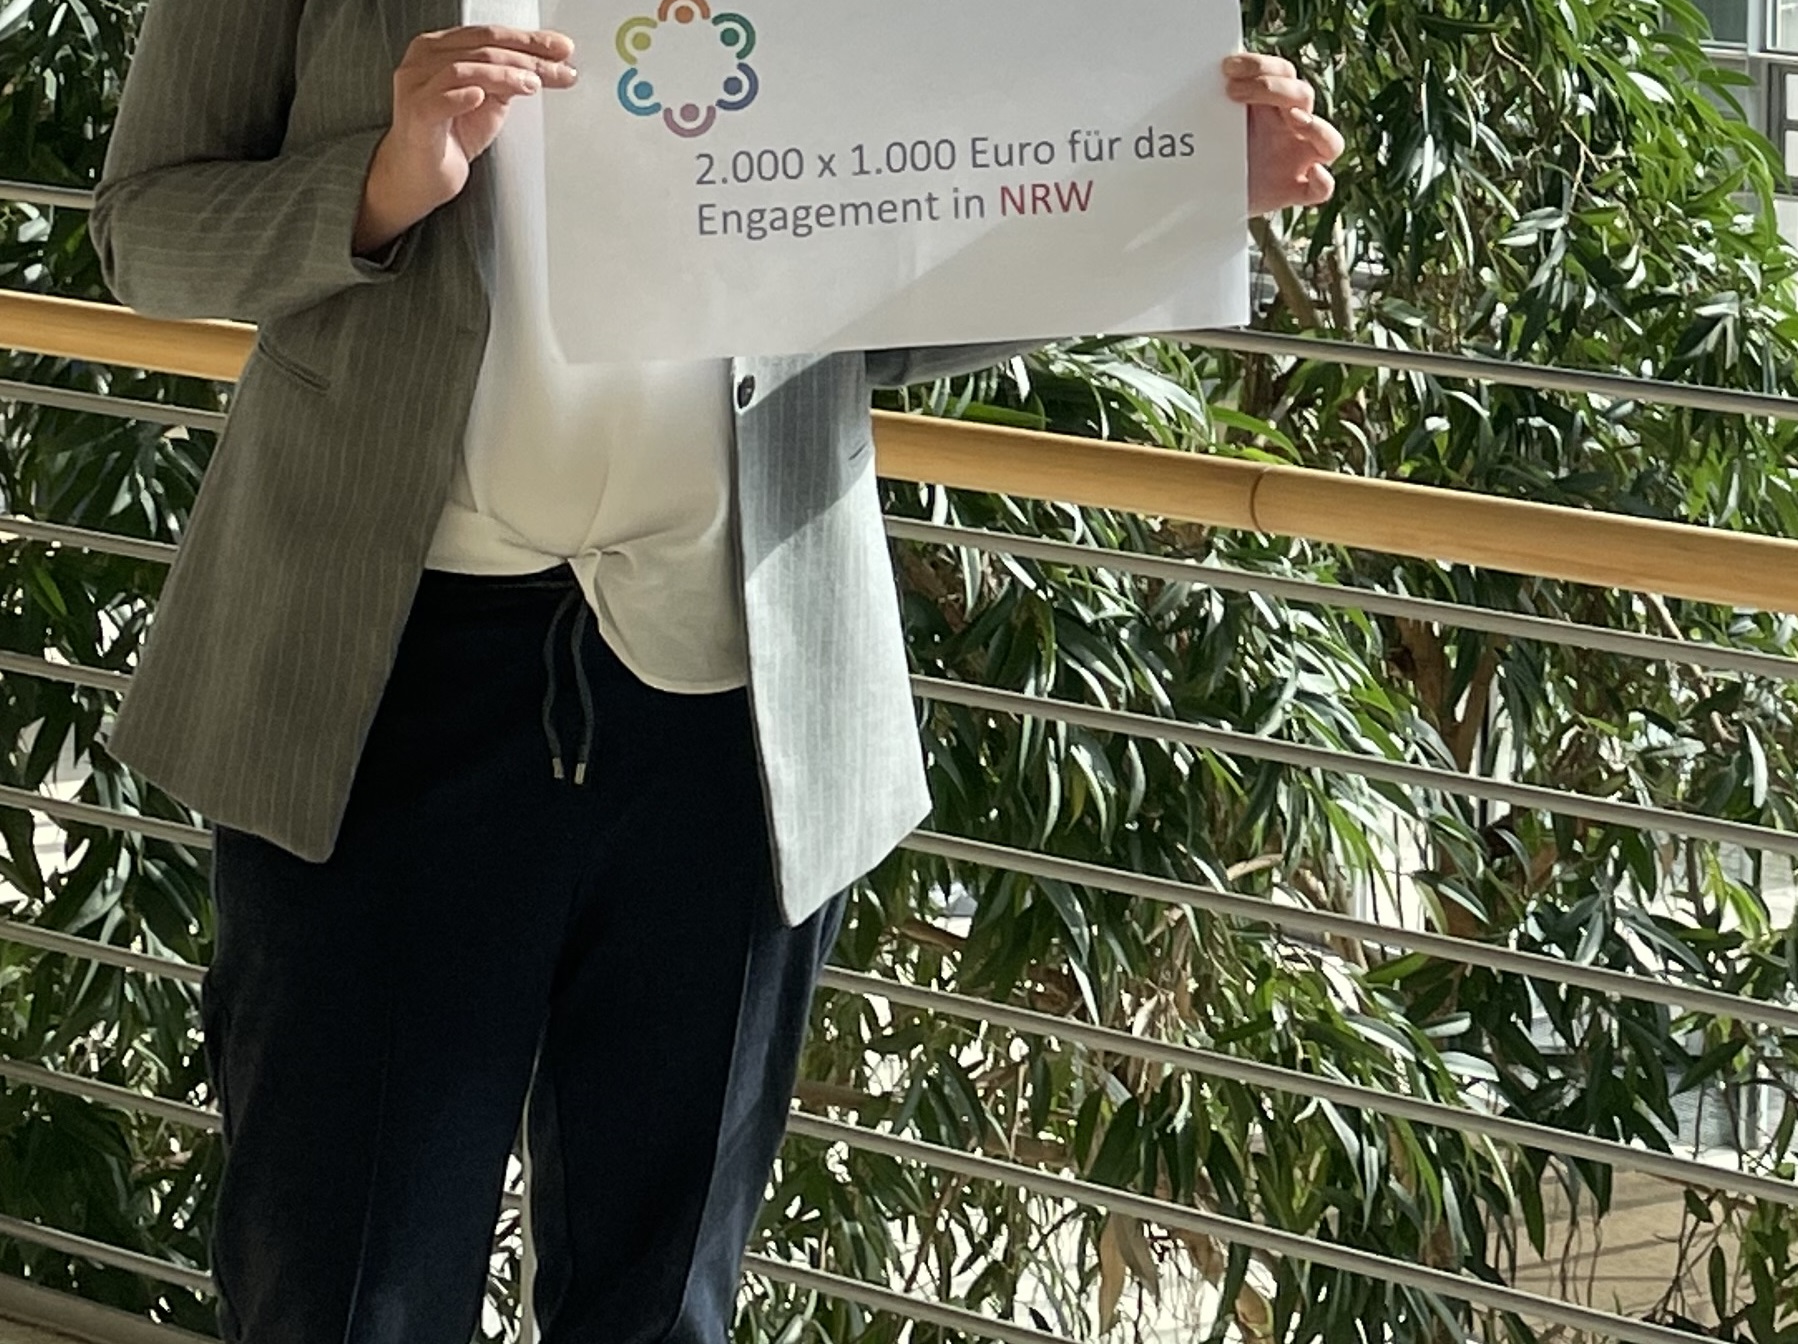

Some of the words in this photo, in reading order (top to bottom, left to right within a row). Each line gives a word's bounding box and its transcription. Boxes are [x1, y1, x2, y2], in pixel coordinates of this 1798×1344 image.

[694, 147, 805, 186] 2.000
[816, 152, 838, 179] x
[850, 138, 957, 177] 1.000
[970, 136, 1056, 169] Euro
[1065, 128, 1123, 164] für
[1133, 125, 1195, 160] das
[697, 191, 941, 242] Engagement
[952, 186, 985, 220] in
[999, 179, 1094, 217] NRW
